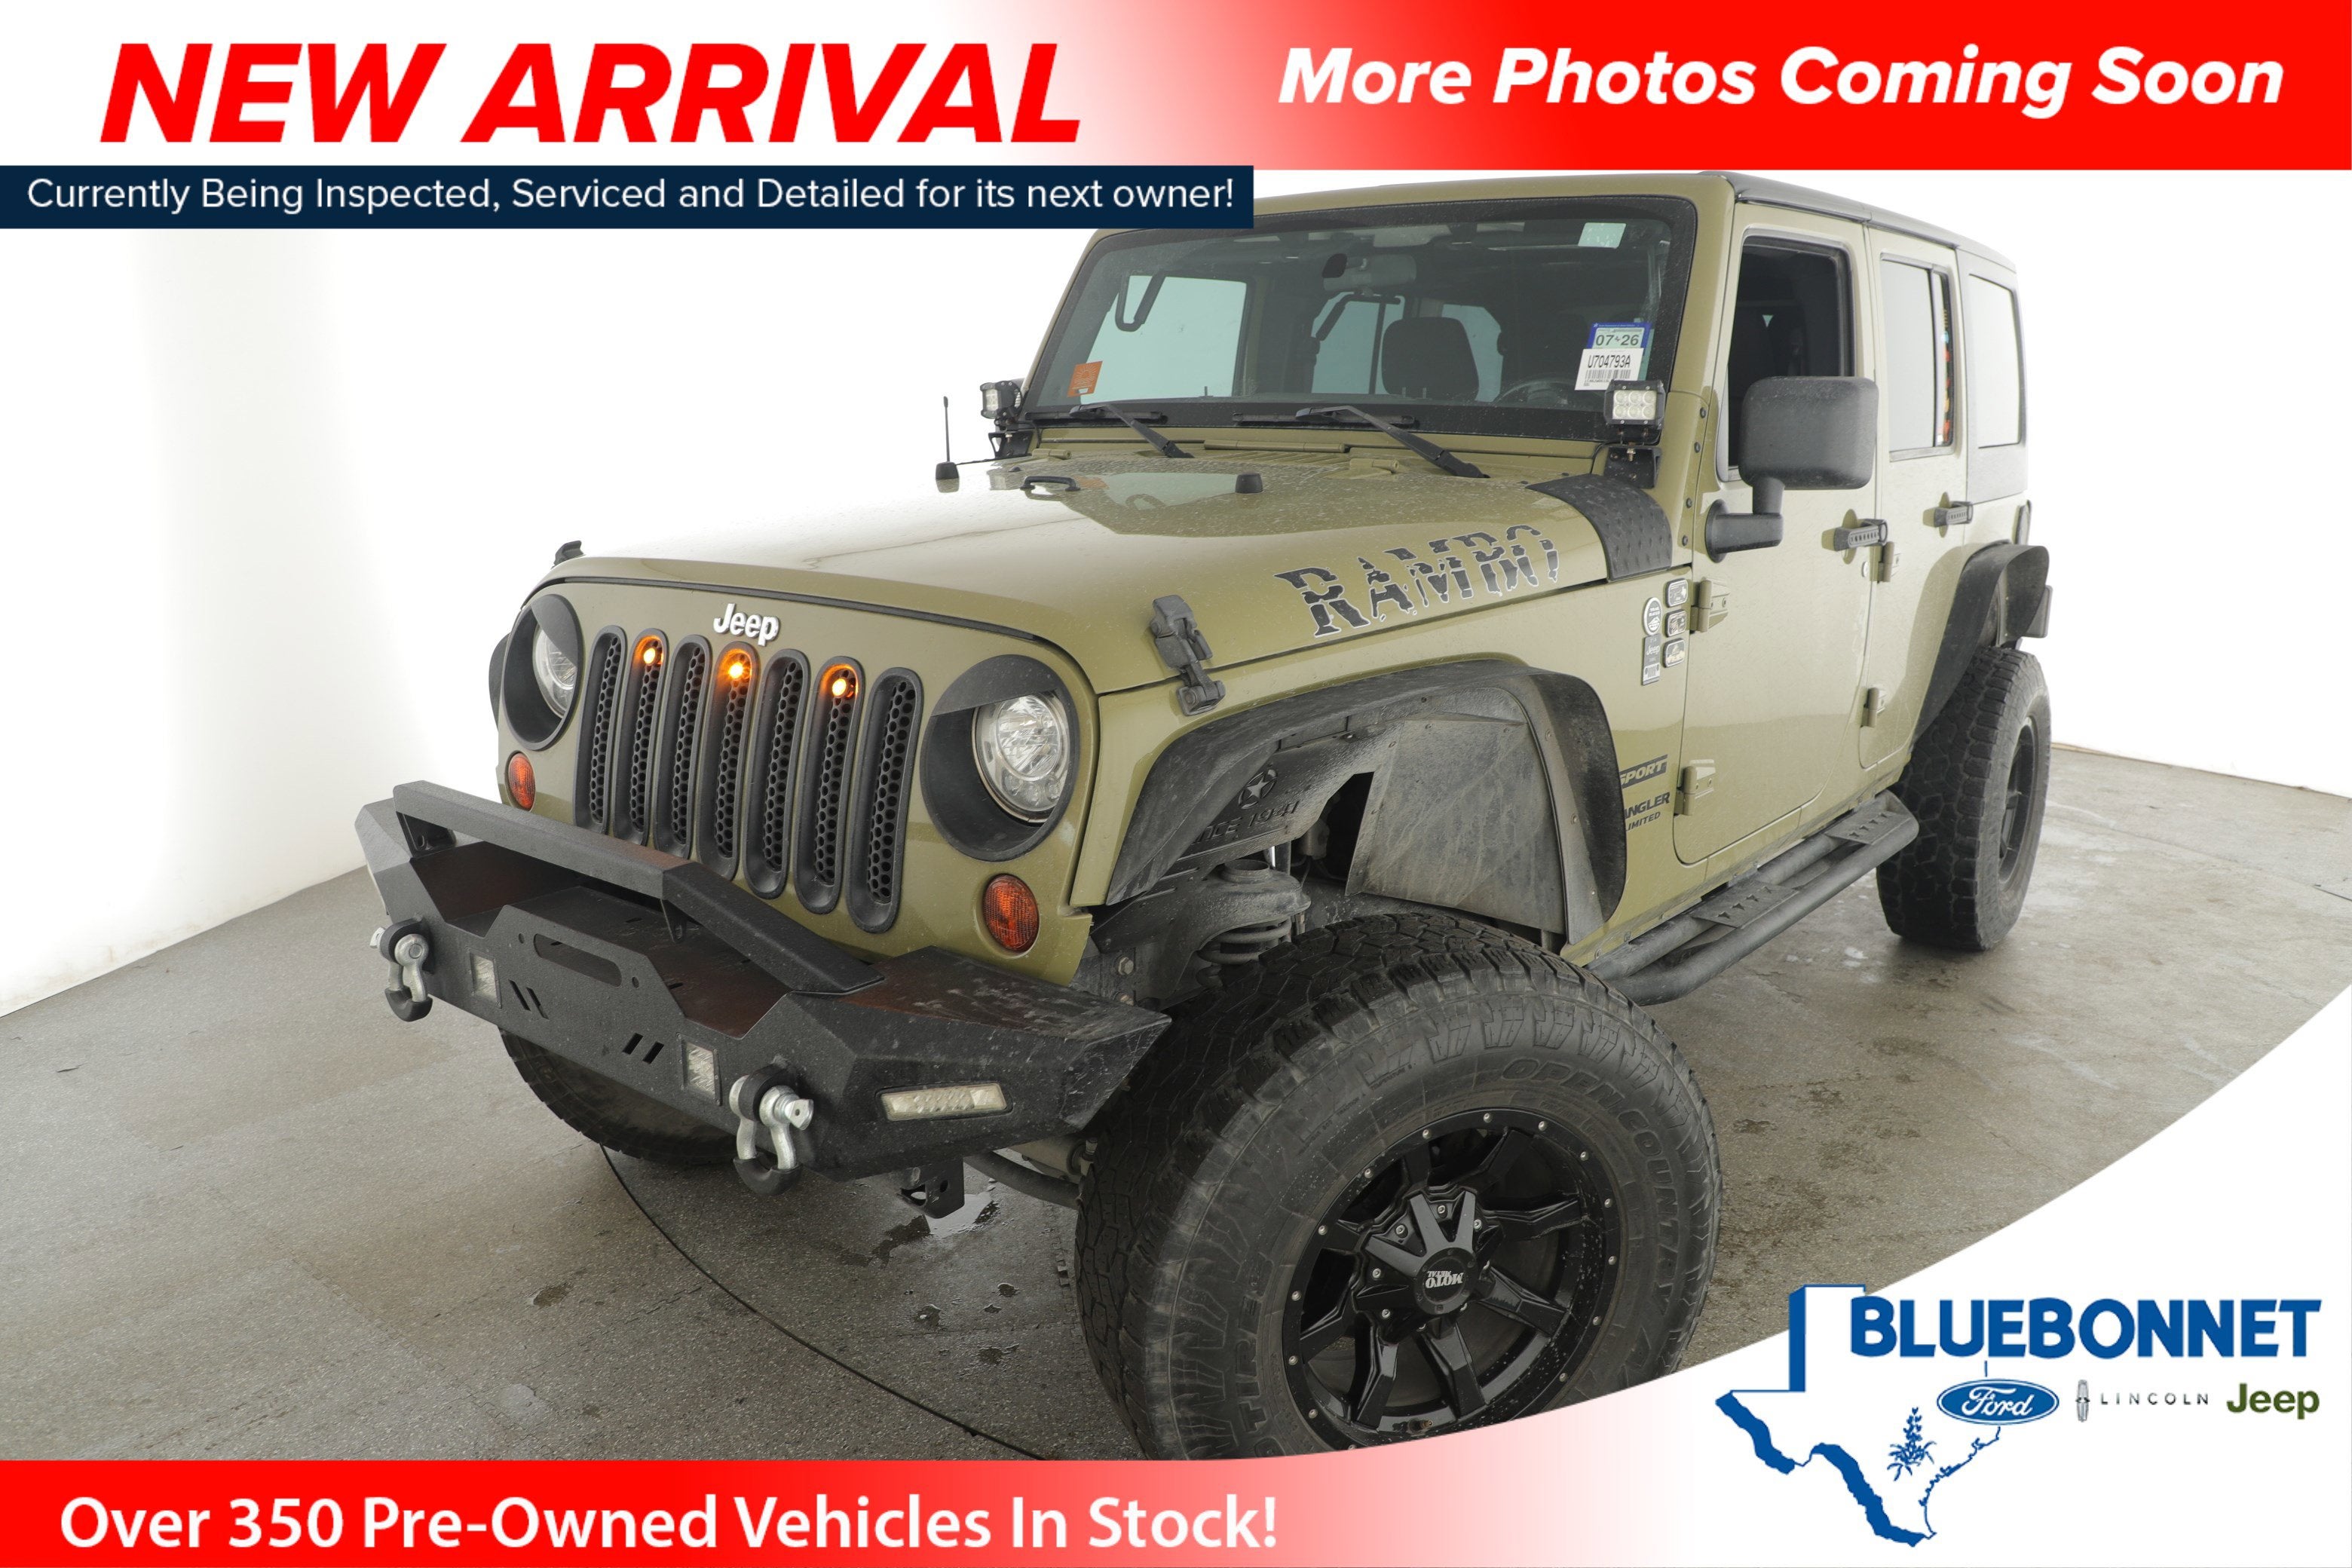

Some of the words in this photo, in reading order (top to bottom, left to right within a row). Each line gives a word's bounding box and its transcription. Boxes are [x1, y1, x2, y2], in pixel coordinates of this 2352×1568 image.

[1595, 334, 1614, 346] 07
[1620, 334, 1640, 346] 26
[1588, 355, 1631, 369] U704793A
[1274, 524, 1560, 639] RAMBO
[713, 603, 780, 647] Jeep
[1646, 645, 1661, 656] Jeep
[1248, 801, 1300, 828] 1941
[1624, 792, 1670, 819] ANGLER
[1502, 1058, 1625, 1110] OPEN
[1617, 1108, 1680, 1315] COUNTRY
[1426, 1272, 1464, 1289] MOTO
[1235, 1251, 1274, 1433] TIRES
